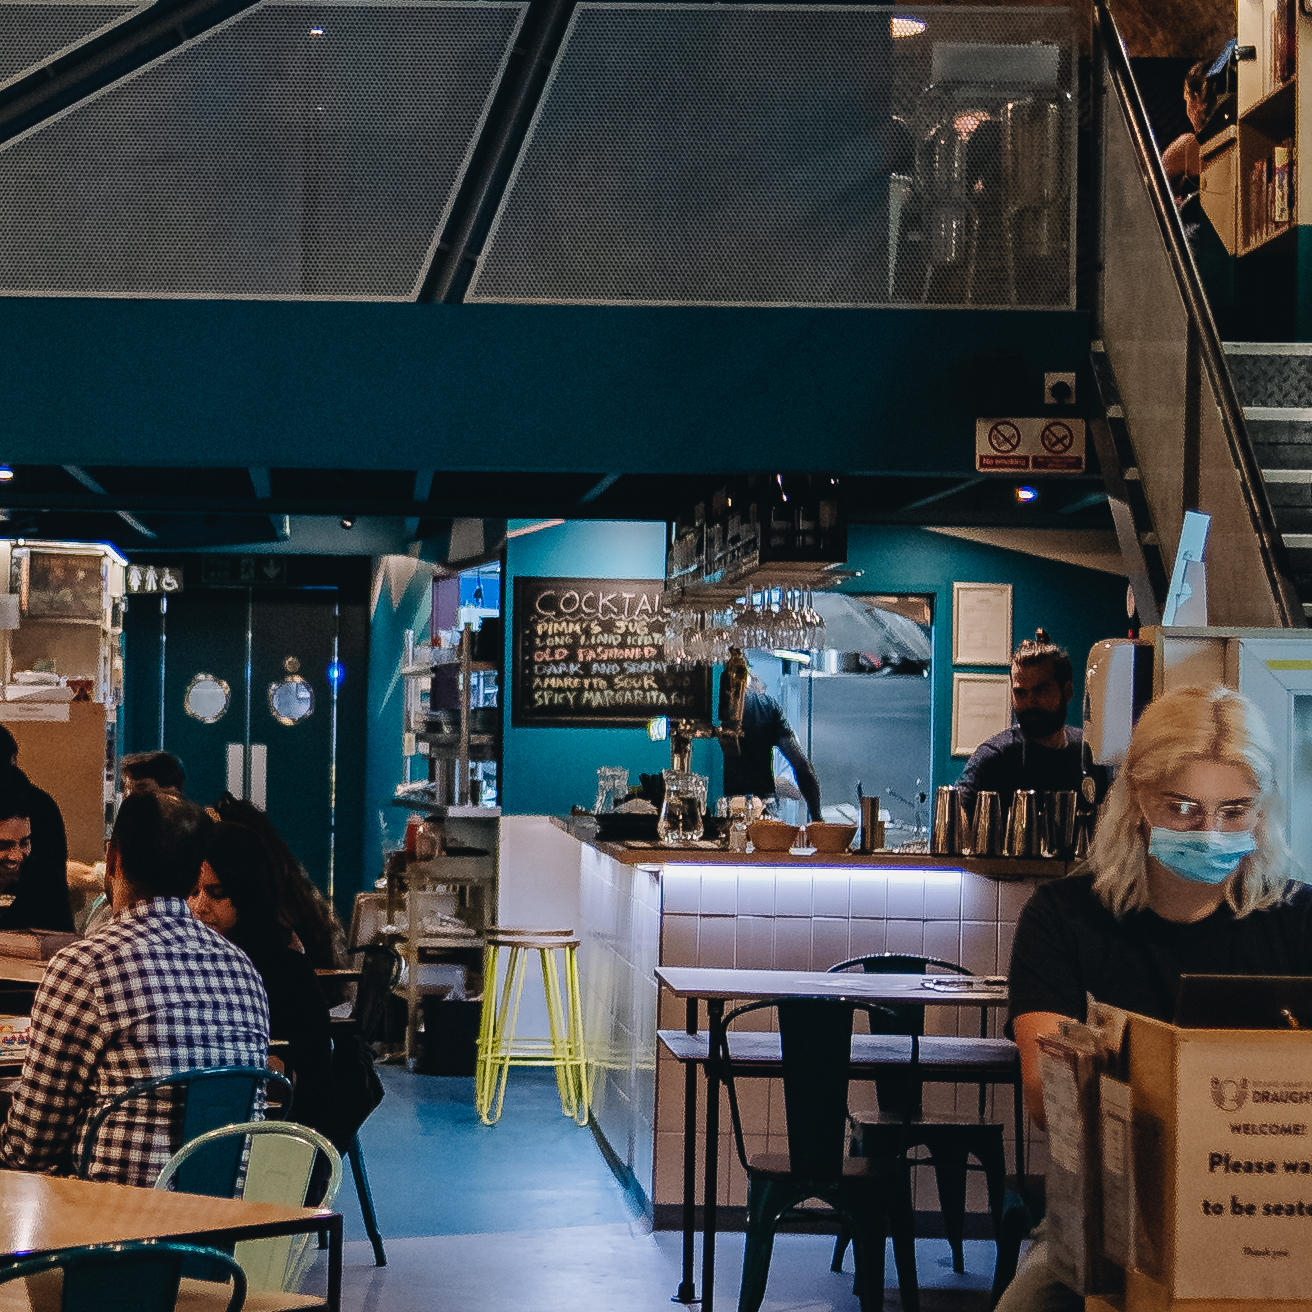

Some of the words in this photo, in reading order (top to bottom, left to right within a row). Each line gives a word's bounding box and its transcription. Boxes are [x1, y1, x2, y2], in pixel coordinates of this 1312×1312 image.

[534, 648, 570, 663] OLD
[577, 646, 658, 663] FASHIONED
[534, 662, 584, 676] DARK
[591, 662, 621, 676] AND
[533, 675, 608, 689] AMARETTO
[613, 674, 659, 689] SOUR
[534, 690, 577, 707] SPICY
[581, 689, 669, 707] MARGARITA
[1229, 1122, 1306, 1136] WELCOME!
[1208, 1151, 1277, 1174] Please
[1202, 1198, 1225, 1217] to
[1229, 1194, 1258, 1217] be
